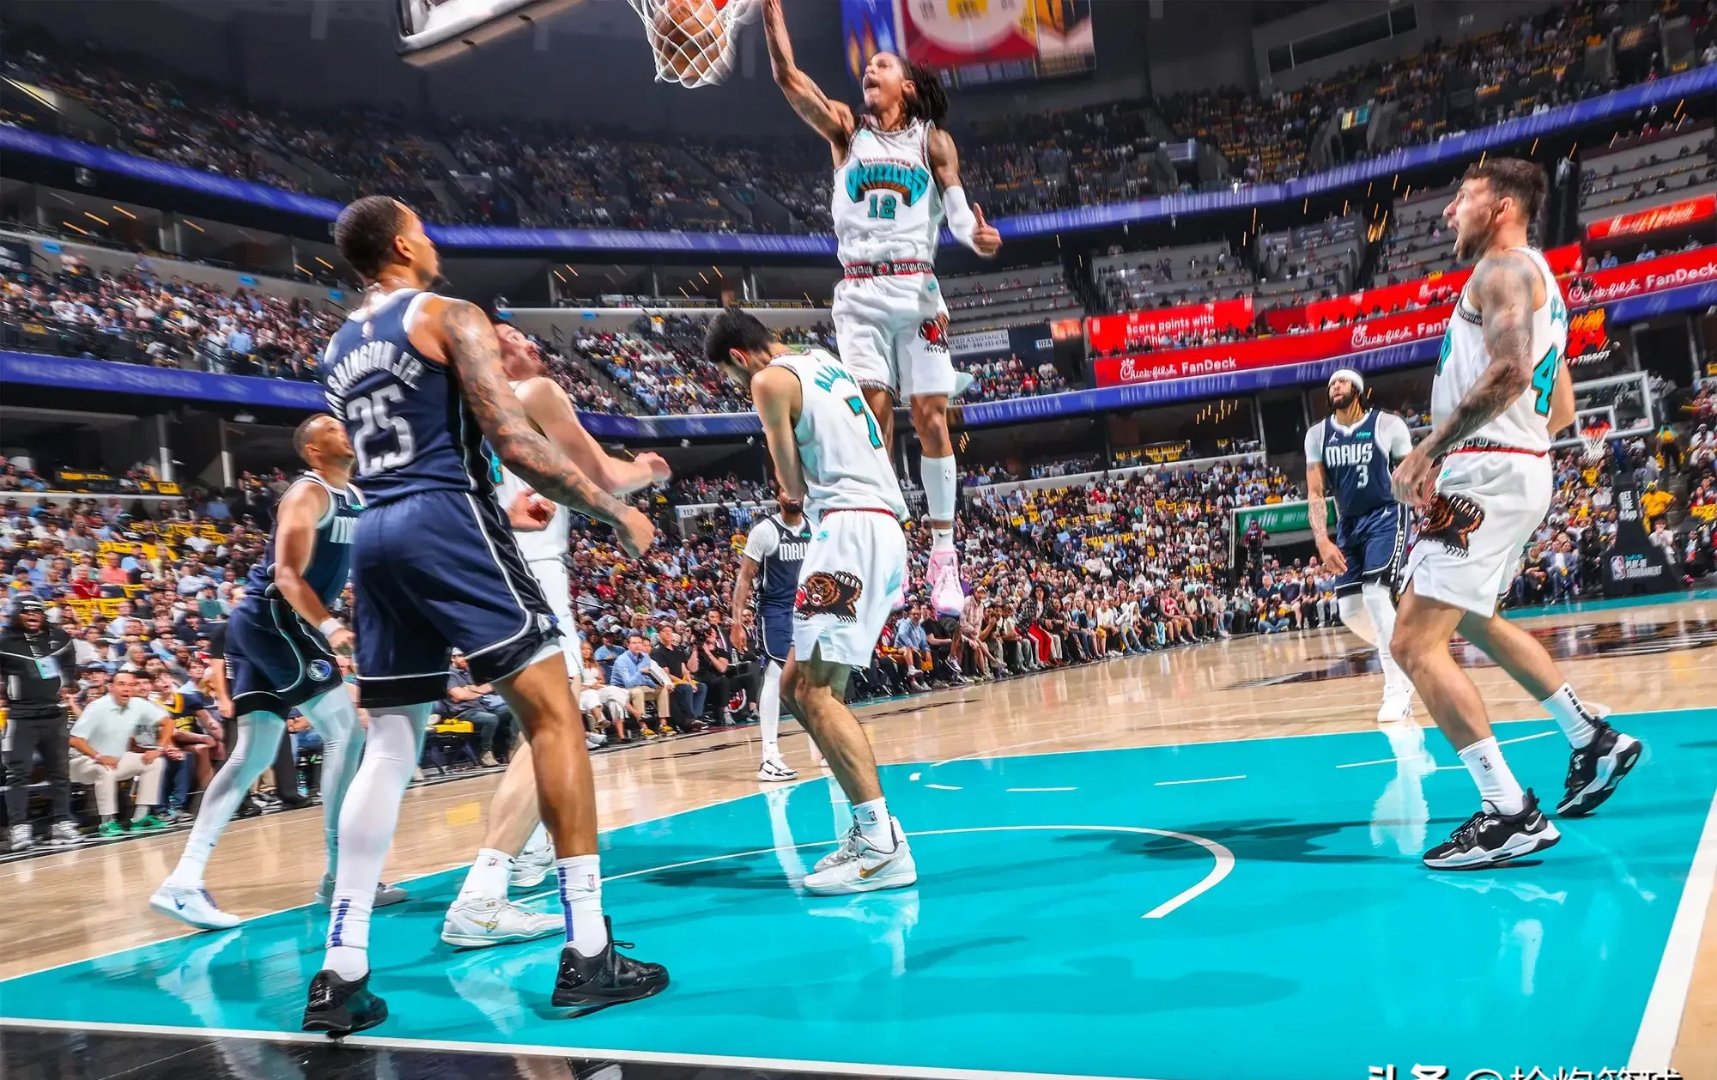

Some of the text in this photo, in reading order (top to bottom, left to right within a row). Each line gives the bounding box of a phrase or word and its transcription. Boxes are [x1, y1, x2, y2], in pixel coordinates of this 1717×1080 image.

[868, 194, 897, 219] 12
[1645, 262, 1717, 288] FanDeck
[1126, 313, 1215, 335] Score points with
[1120, 356, 1237, 381] Chick-fil-A FanDeck
[1579, 349, 1612, 364] TISSOT
[1531, 343, 1562, 417] 4
[346, 384, 415, 477] 25
[842, 395, 884, 450] 7
[1325, 442, 1373, 469] MAVS
[1356, 464, 1369, 489] 3
[683, 509, 695, 517] 112
